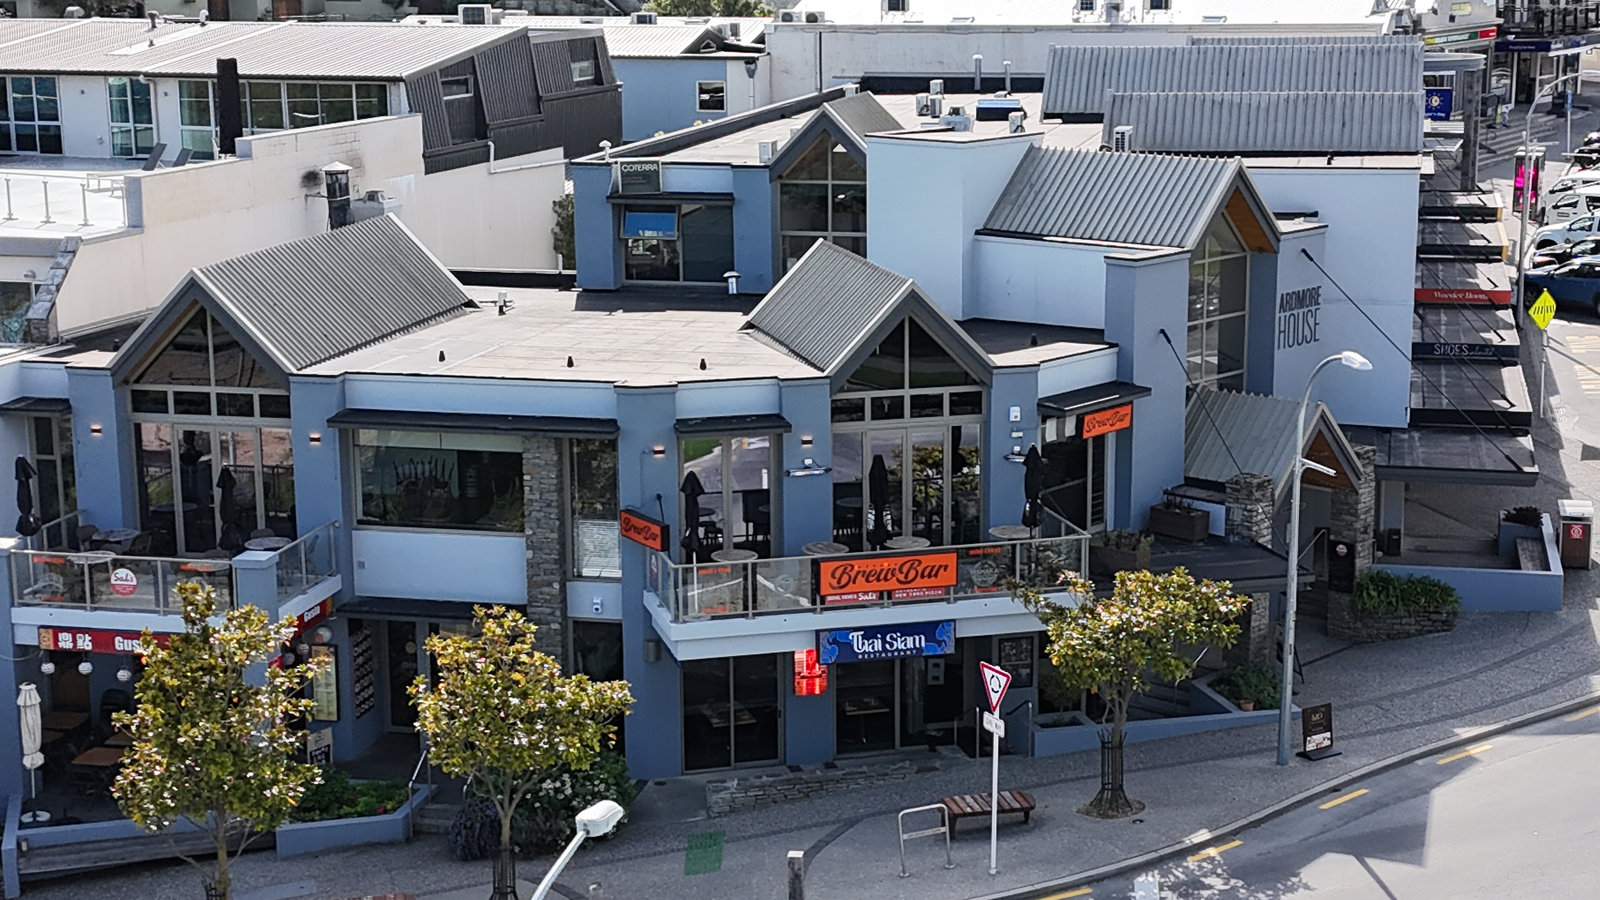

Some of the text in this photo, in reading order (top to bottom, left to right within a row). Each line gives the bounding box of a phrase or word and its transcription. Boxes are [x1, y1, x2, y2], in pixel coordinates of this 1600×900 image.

[622, 164, 658, 172] COTERRA
[1279, 285, 1322, 314] ARDMORE
[1277, 307, 1321, 351] HOUSE
[848, 631, 926, 653] Thai Siam
[858, 650, 917, 659] RESTAURANT
